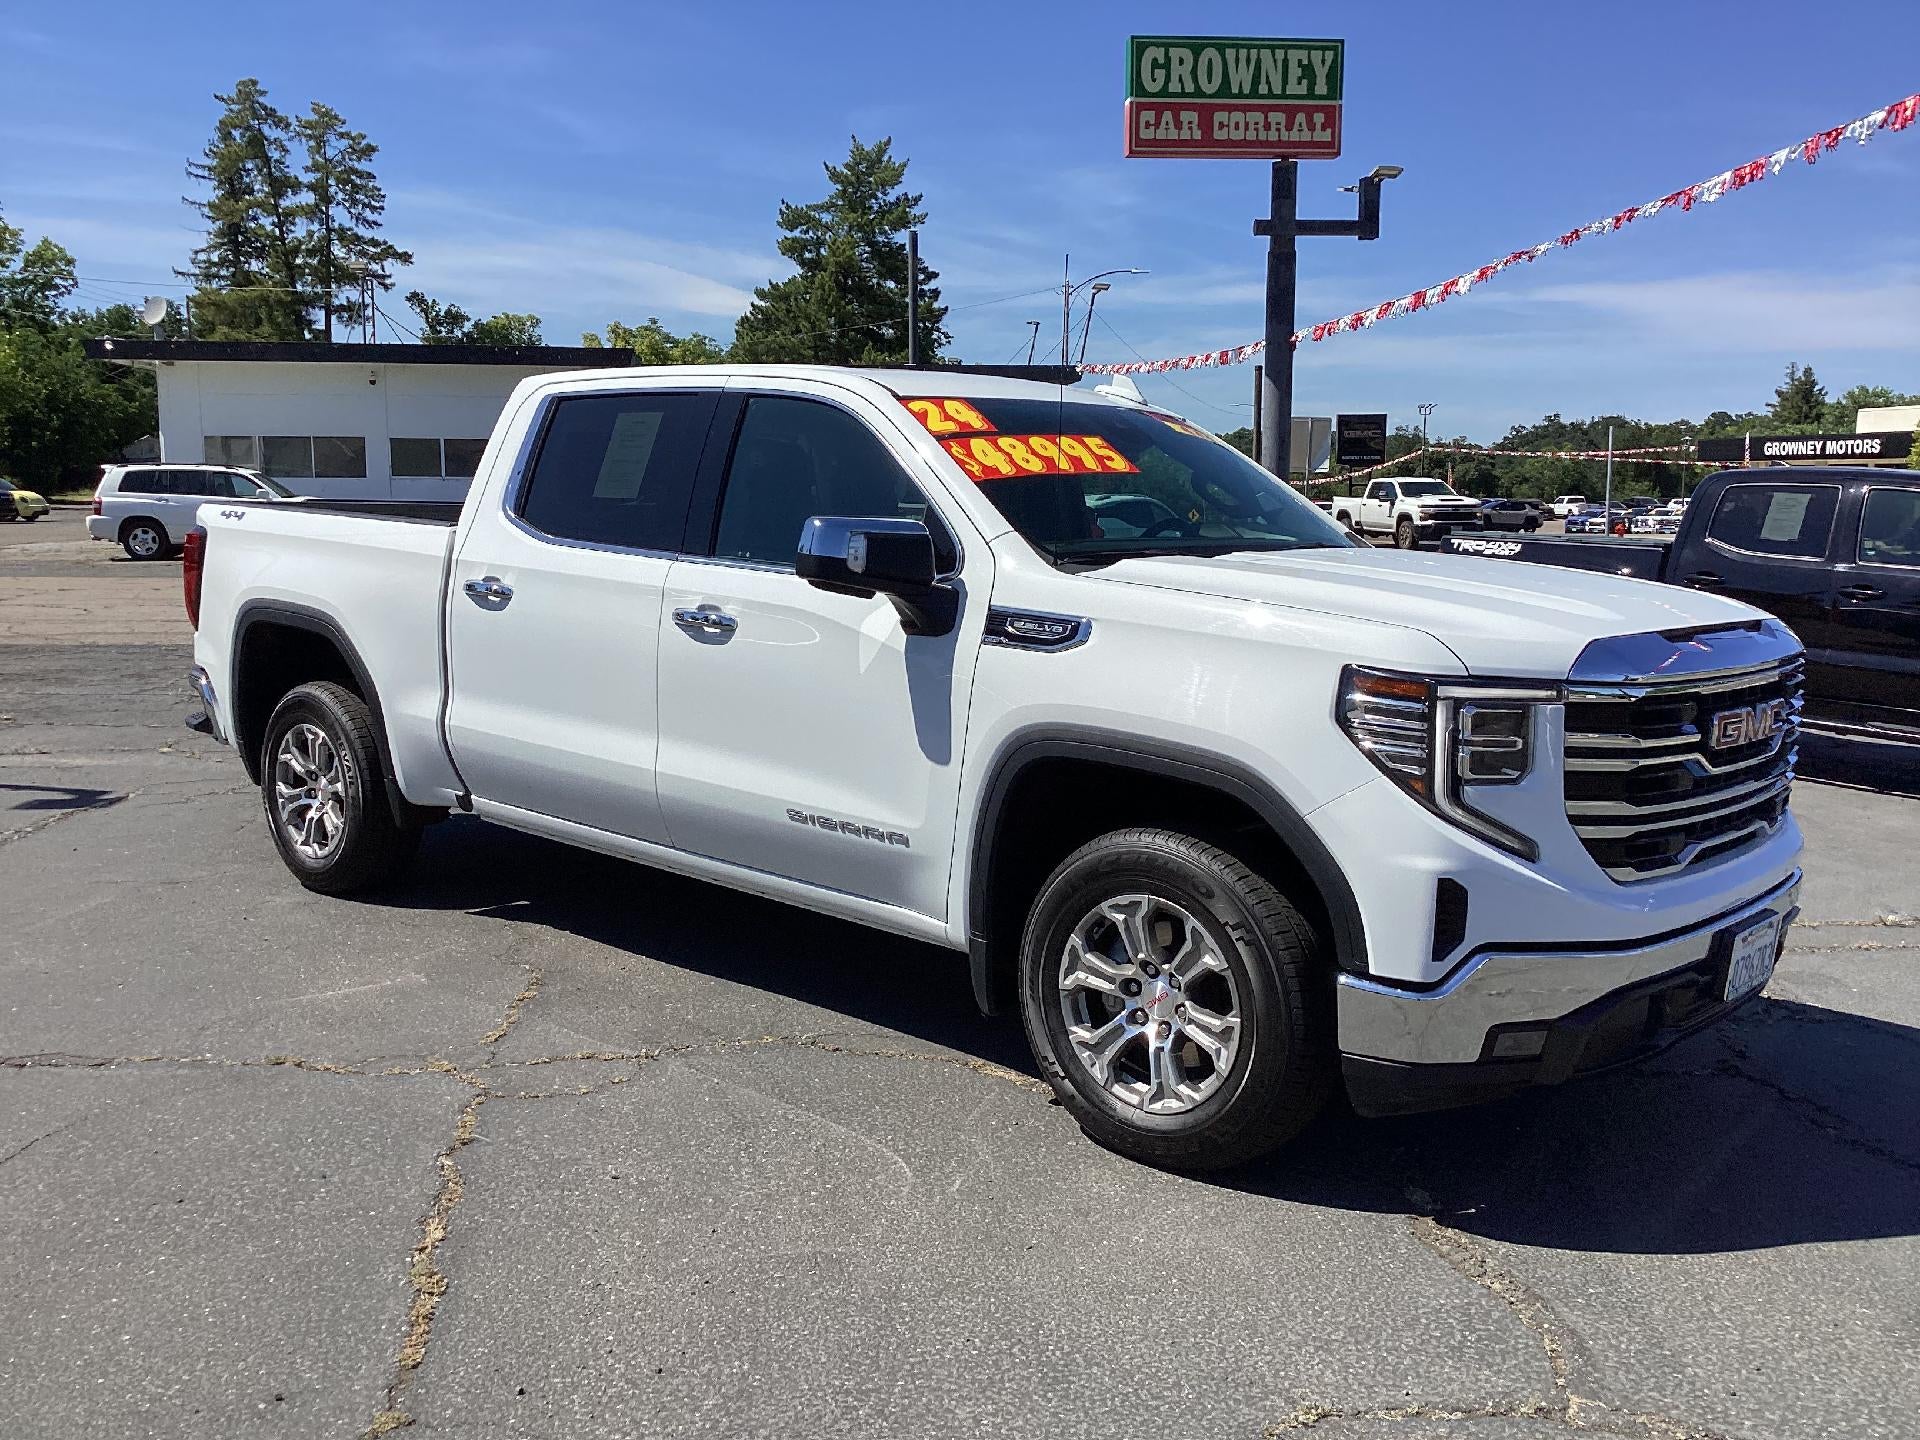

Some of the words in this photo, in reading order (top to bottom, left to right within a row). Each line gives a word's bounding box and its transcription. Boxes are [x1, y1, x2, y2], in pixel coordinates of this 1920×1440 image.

[1141, 46, 1334, 95] GROWNEY
[1140, 110, 1201, 140] CAR
[1213, 111, 1331, 141] CORRAL
[907, 400, 988, 432] 24
[950, 436, 1130, 477] $48995
[1763, 441, 1823, 456] GROWNEY
[1825, 438, 1881, 455] MOTORS
[1711, 698, 1786, 750] GMC
[786, 808, 910, 848] SIERRA
[1145, 991, 1169, 1009] GMC
